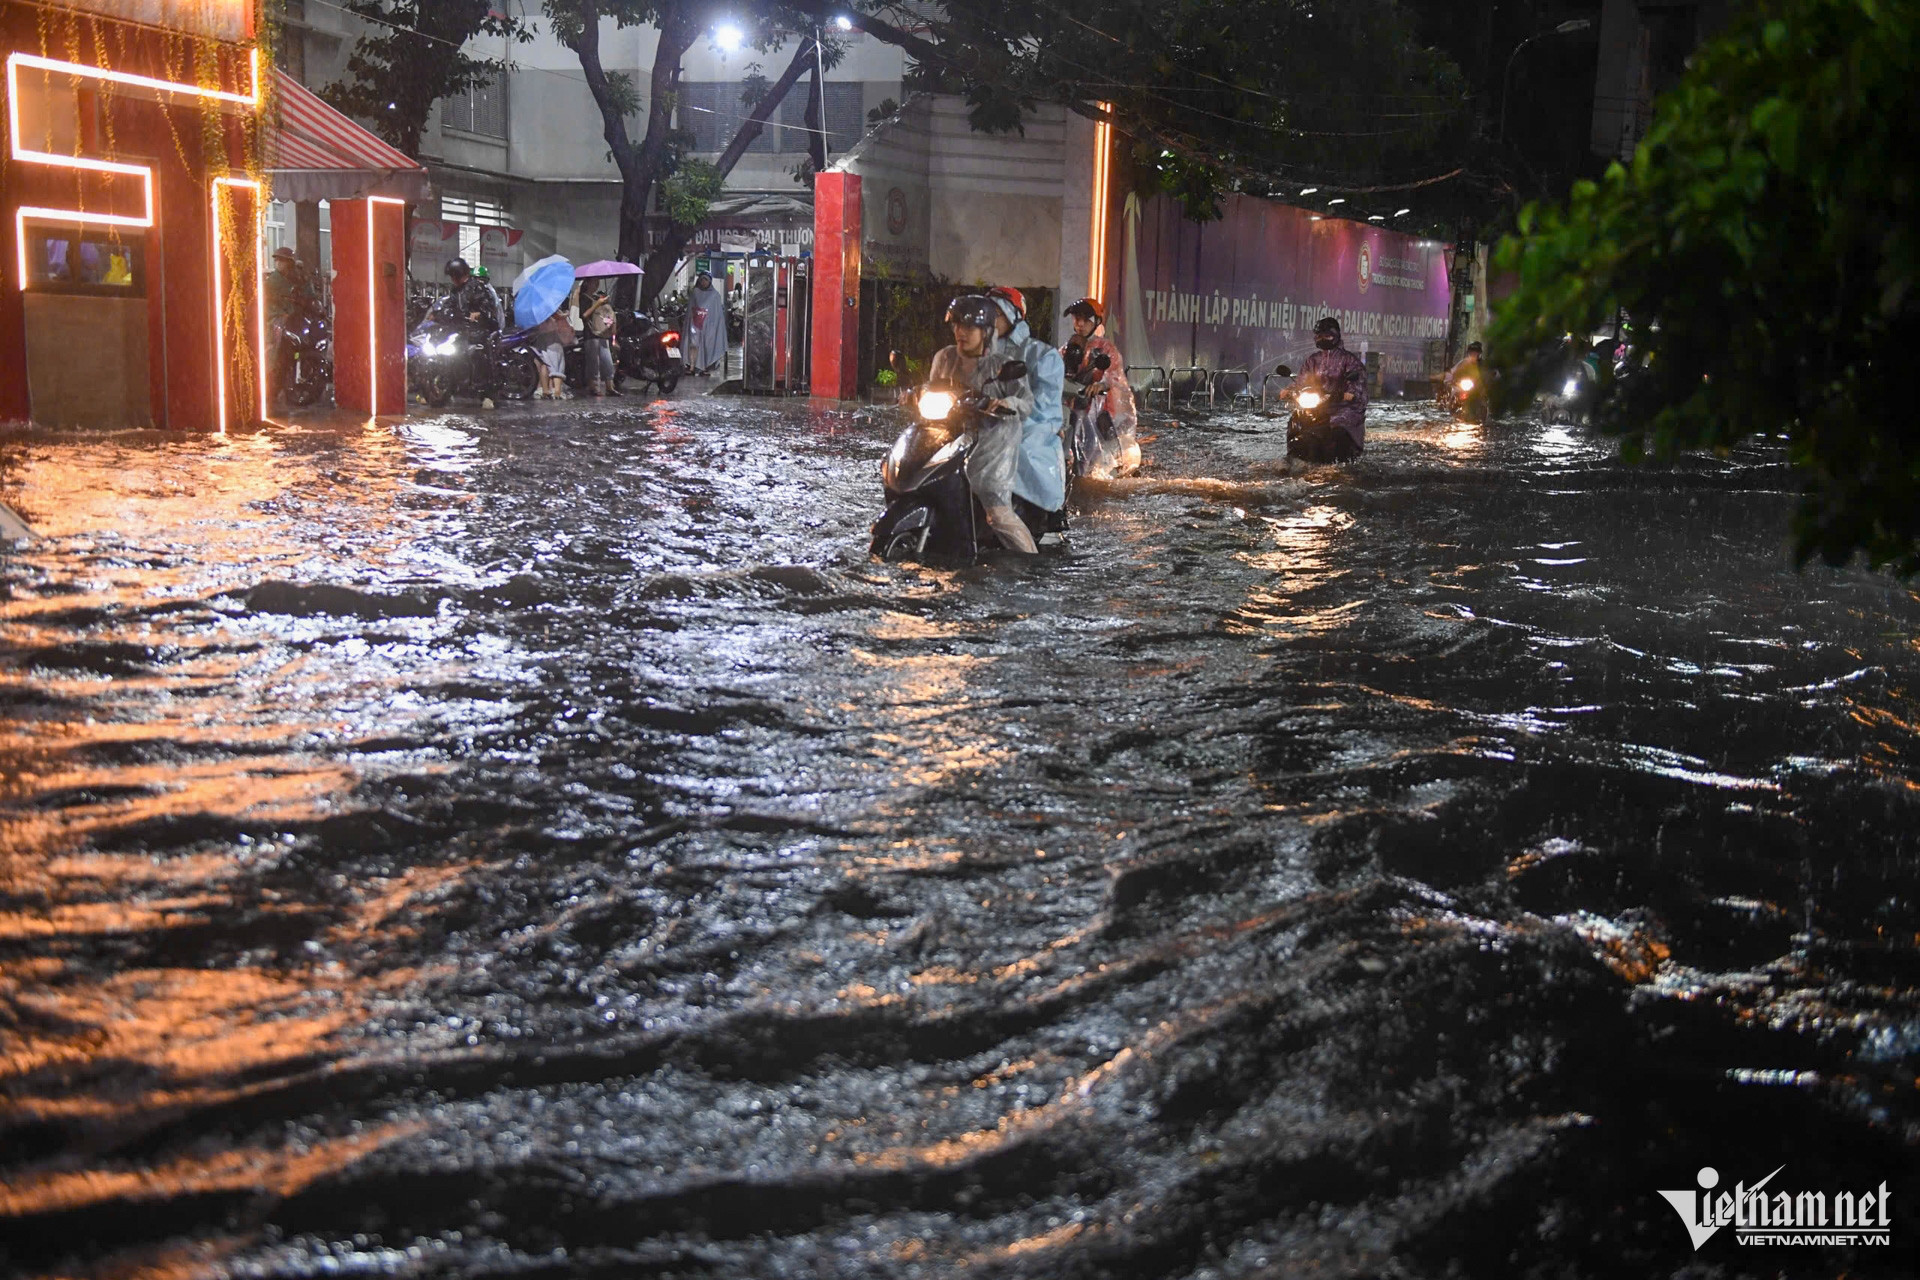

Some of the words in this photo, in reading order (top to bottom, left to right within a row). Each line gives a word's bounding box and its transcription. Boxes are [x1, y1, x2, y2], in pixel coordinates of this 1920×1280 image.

[778, 226, 815, 245] THƯƠN
[1145, 284, 1200, 323] THÀNH
[1204, 289, 1229, 333] LẬP
[1232, 293, 1267, 328] PHÂN
[1270, 296, 1297, 336] HIỆU
[1412, 316, 1443, 338] THƯƠNG
